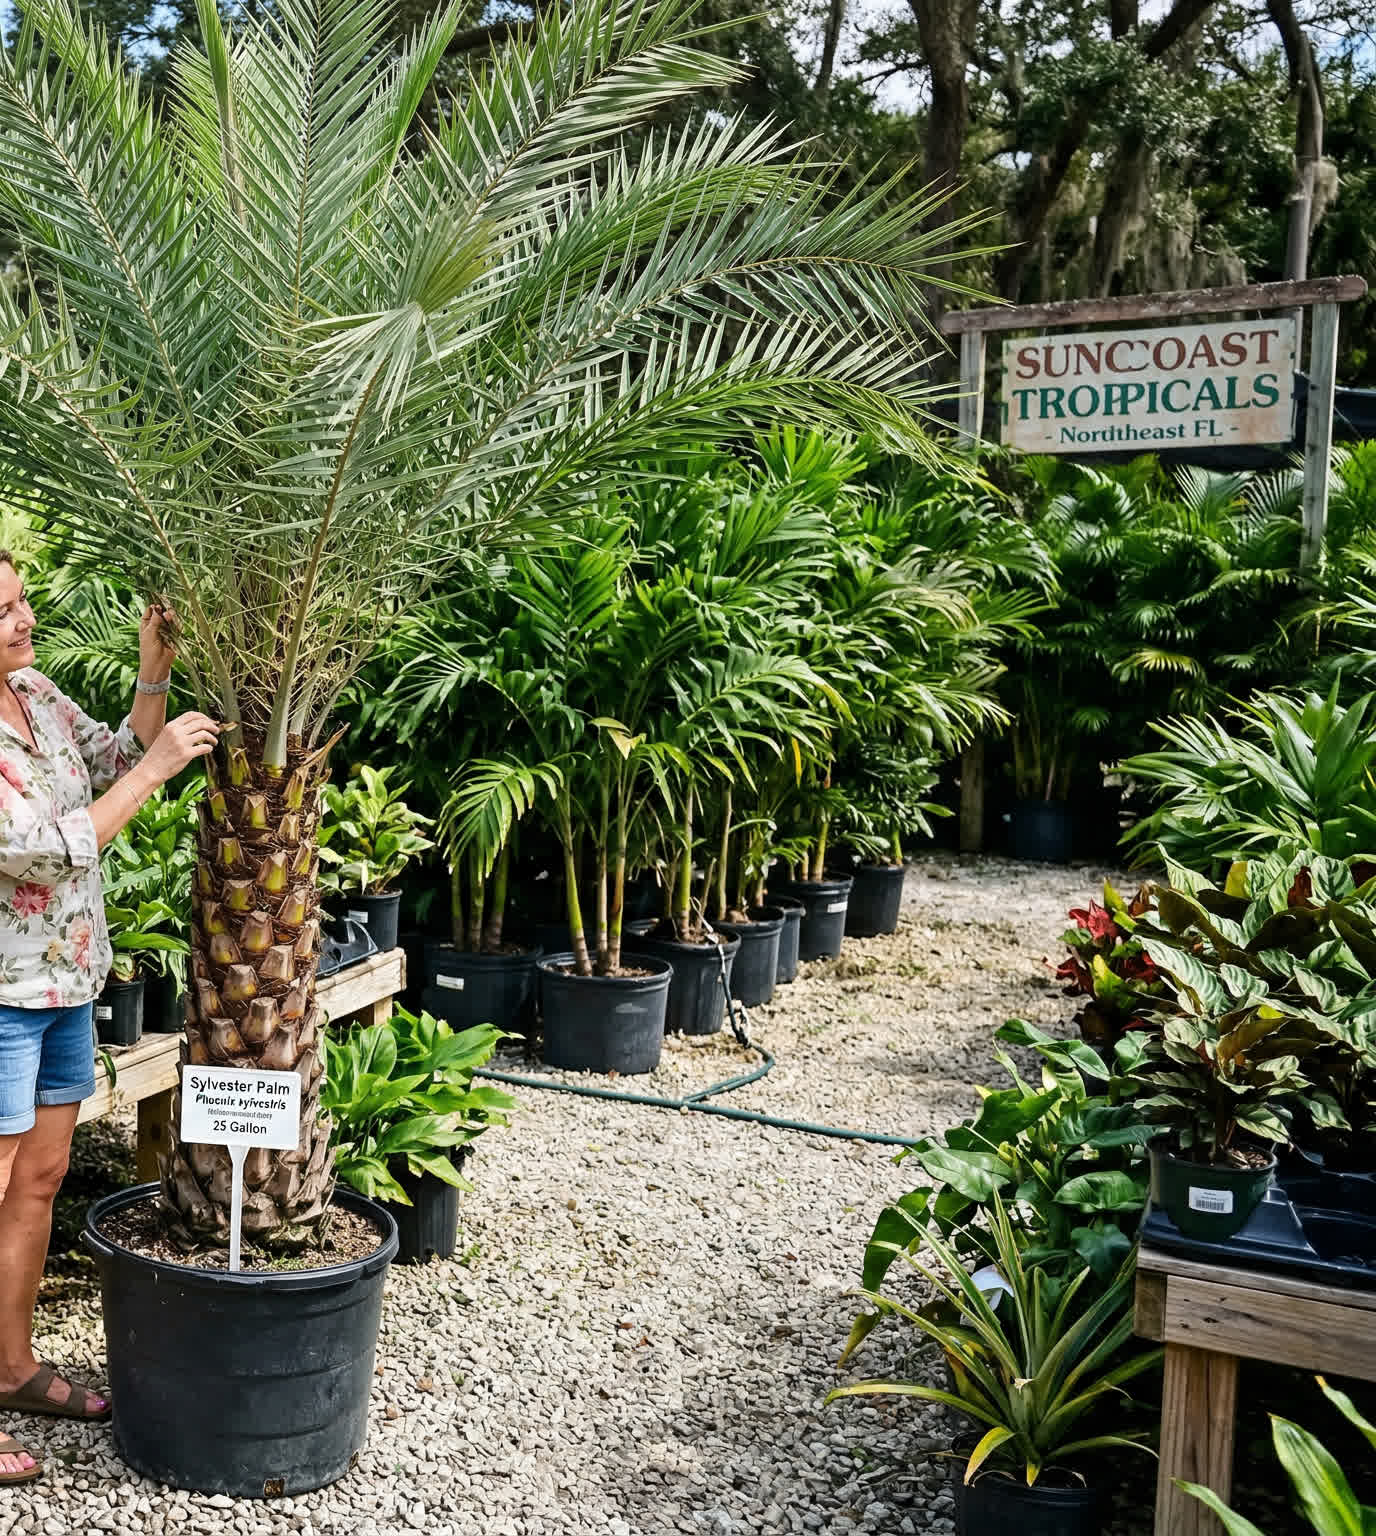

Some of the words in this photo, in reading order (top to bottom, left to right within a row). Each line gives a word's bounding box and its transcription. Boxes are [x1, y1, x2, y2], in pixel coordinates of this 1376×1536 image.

[1194, 419, 1223, 438] FL
[190, 1076, 253, 1093] Sylvester
[257, 1081, 290, 1095] Palm
[213, 1120, 227, 1132] 25
[230, 1121, 267, 1134] Gallon
